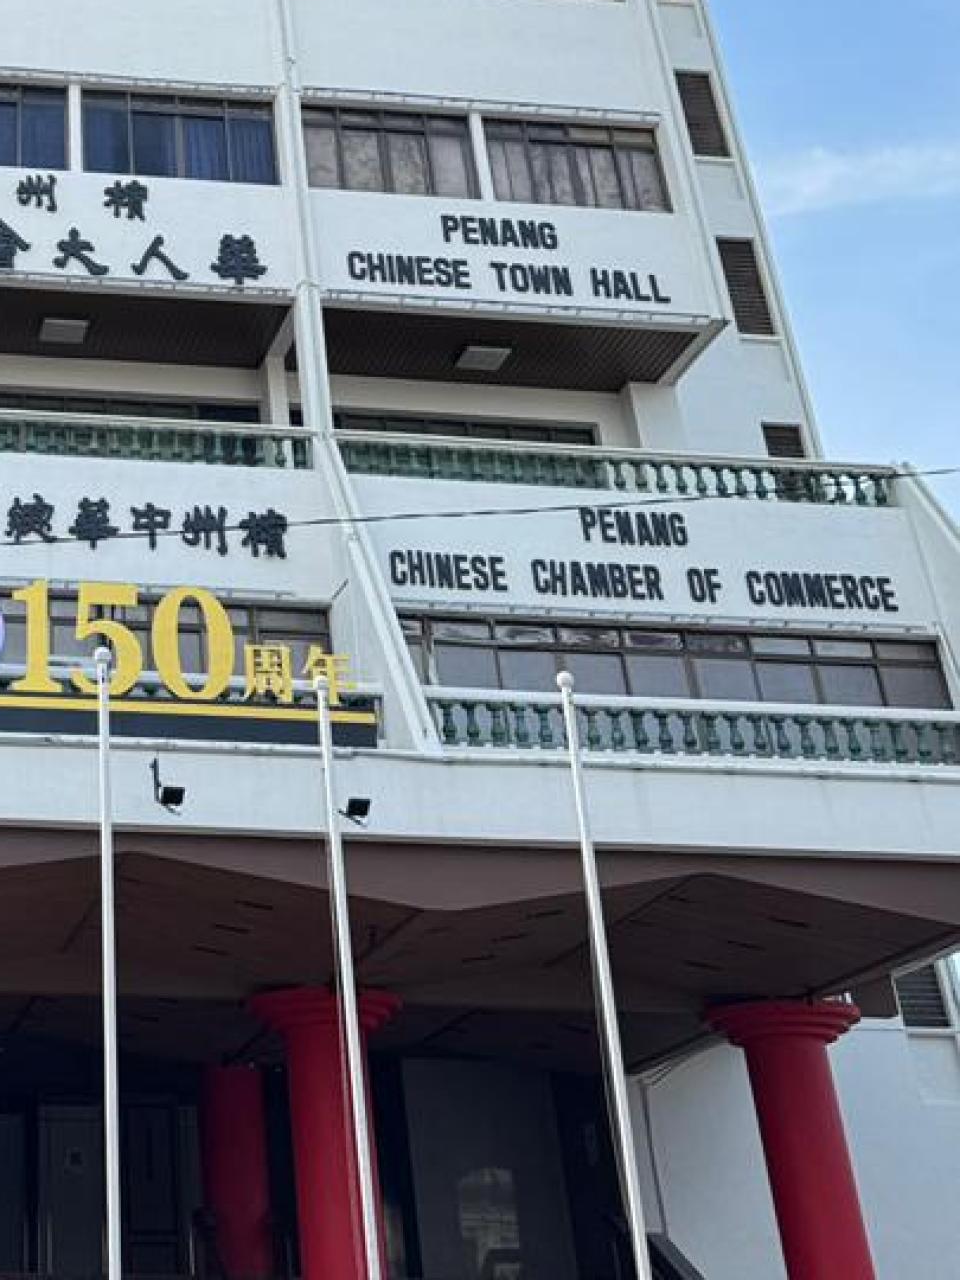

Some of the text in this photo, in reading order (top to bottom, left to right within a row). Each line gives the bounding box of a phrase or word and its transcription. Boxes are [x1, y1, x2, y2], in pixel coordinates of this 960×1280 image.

[440, 215, 558, 250] PENANG
[347, 250, 672, 304] CHINESE TOWN HALL
[578, 507, 689, 547] PENANG
[388, 549, 899, 613] CHINESE CHAMBER OF COMMERCE
